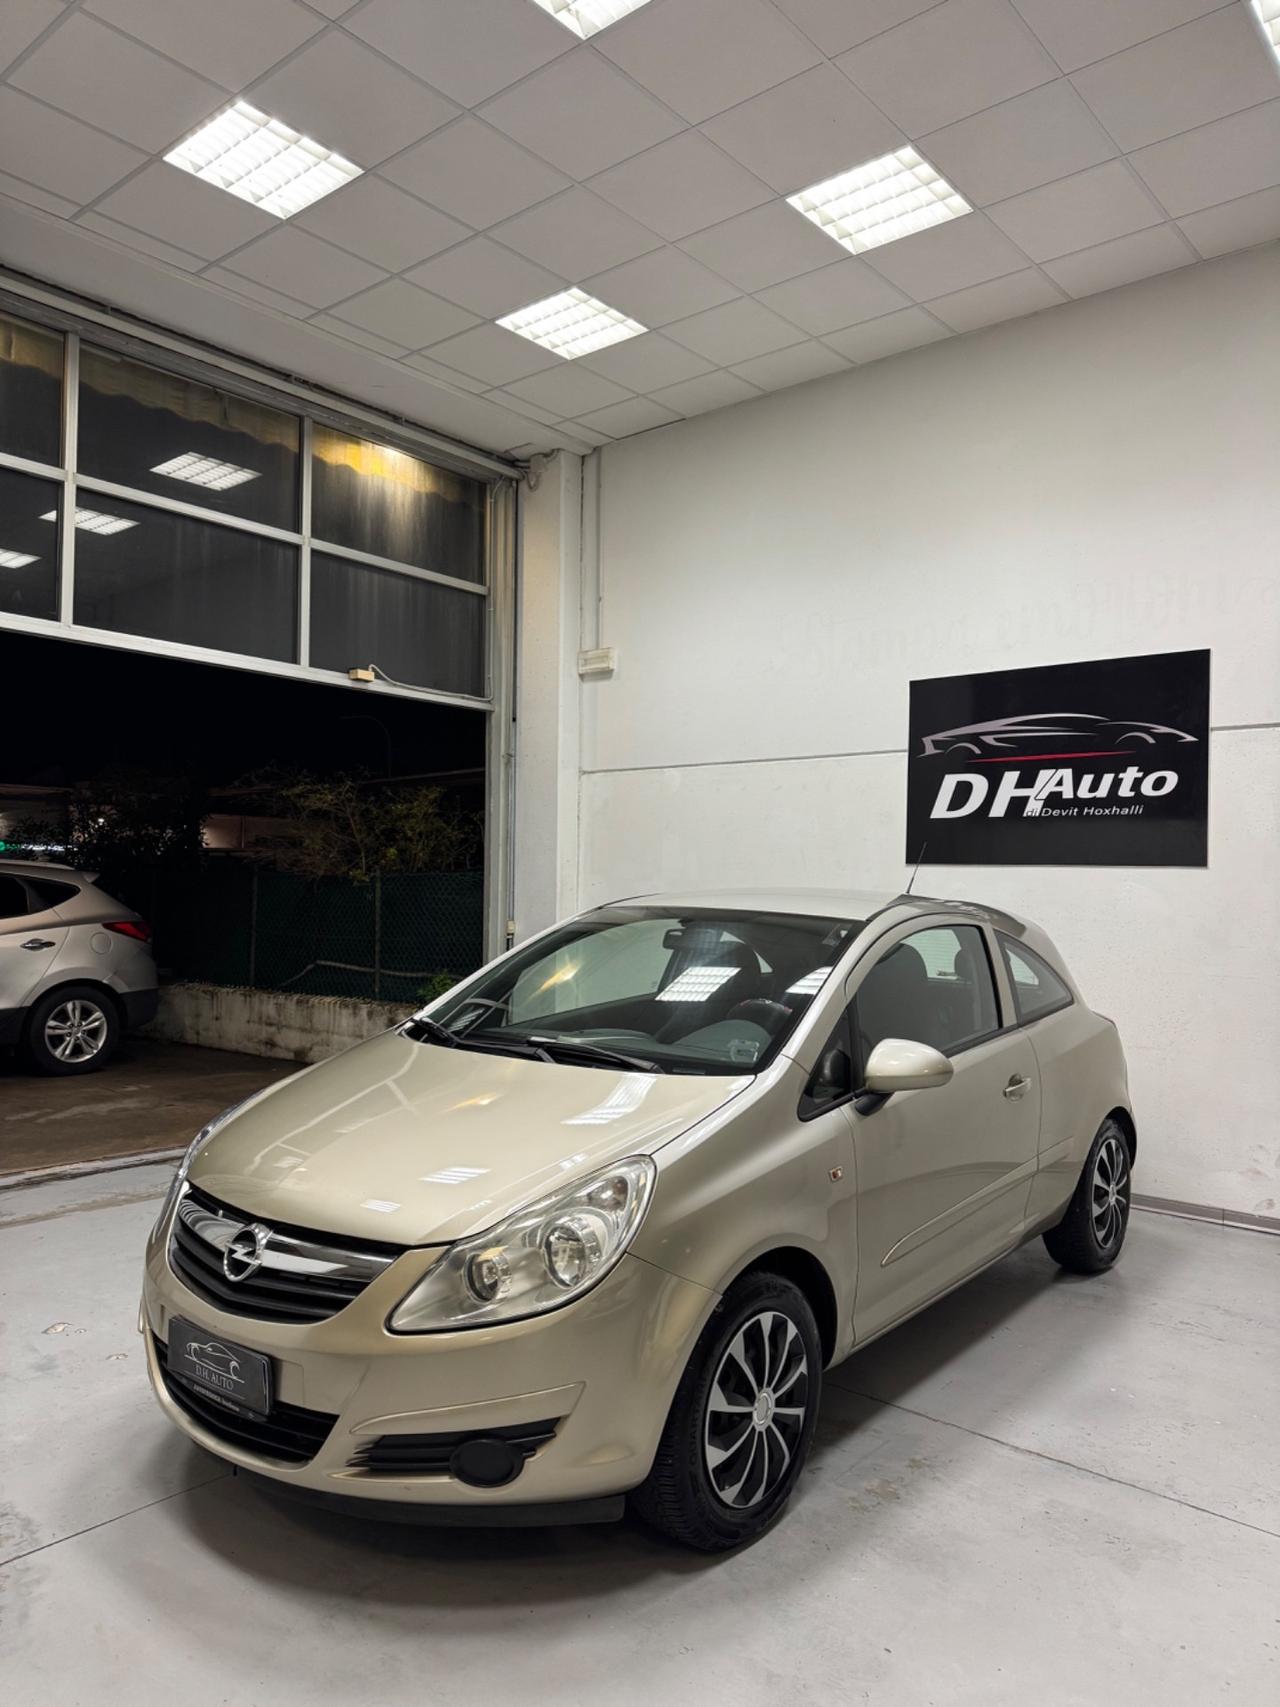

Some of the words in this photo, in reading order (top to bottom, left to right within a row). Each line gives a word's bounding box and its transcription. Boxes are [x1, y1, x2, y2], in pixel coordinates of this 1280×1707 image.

[1041, 806, 1078, 818] Devit
[1083, 804, 1144, 817] Hoxhalli
[211, 1373, 234, 1391] AUTO
